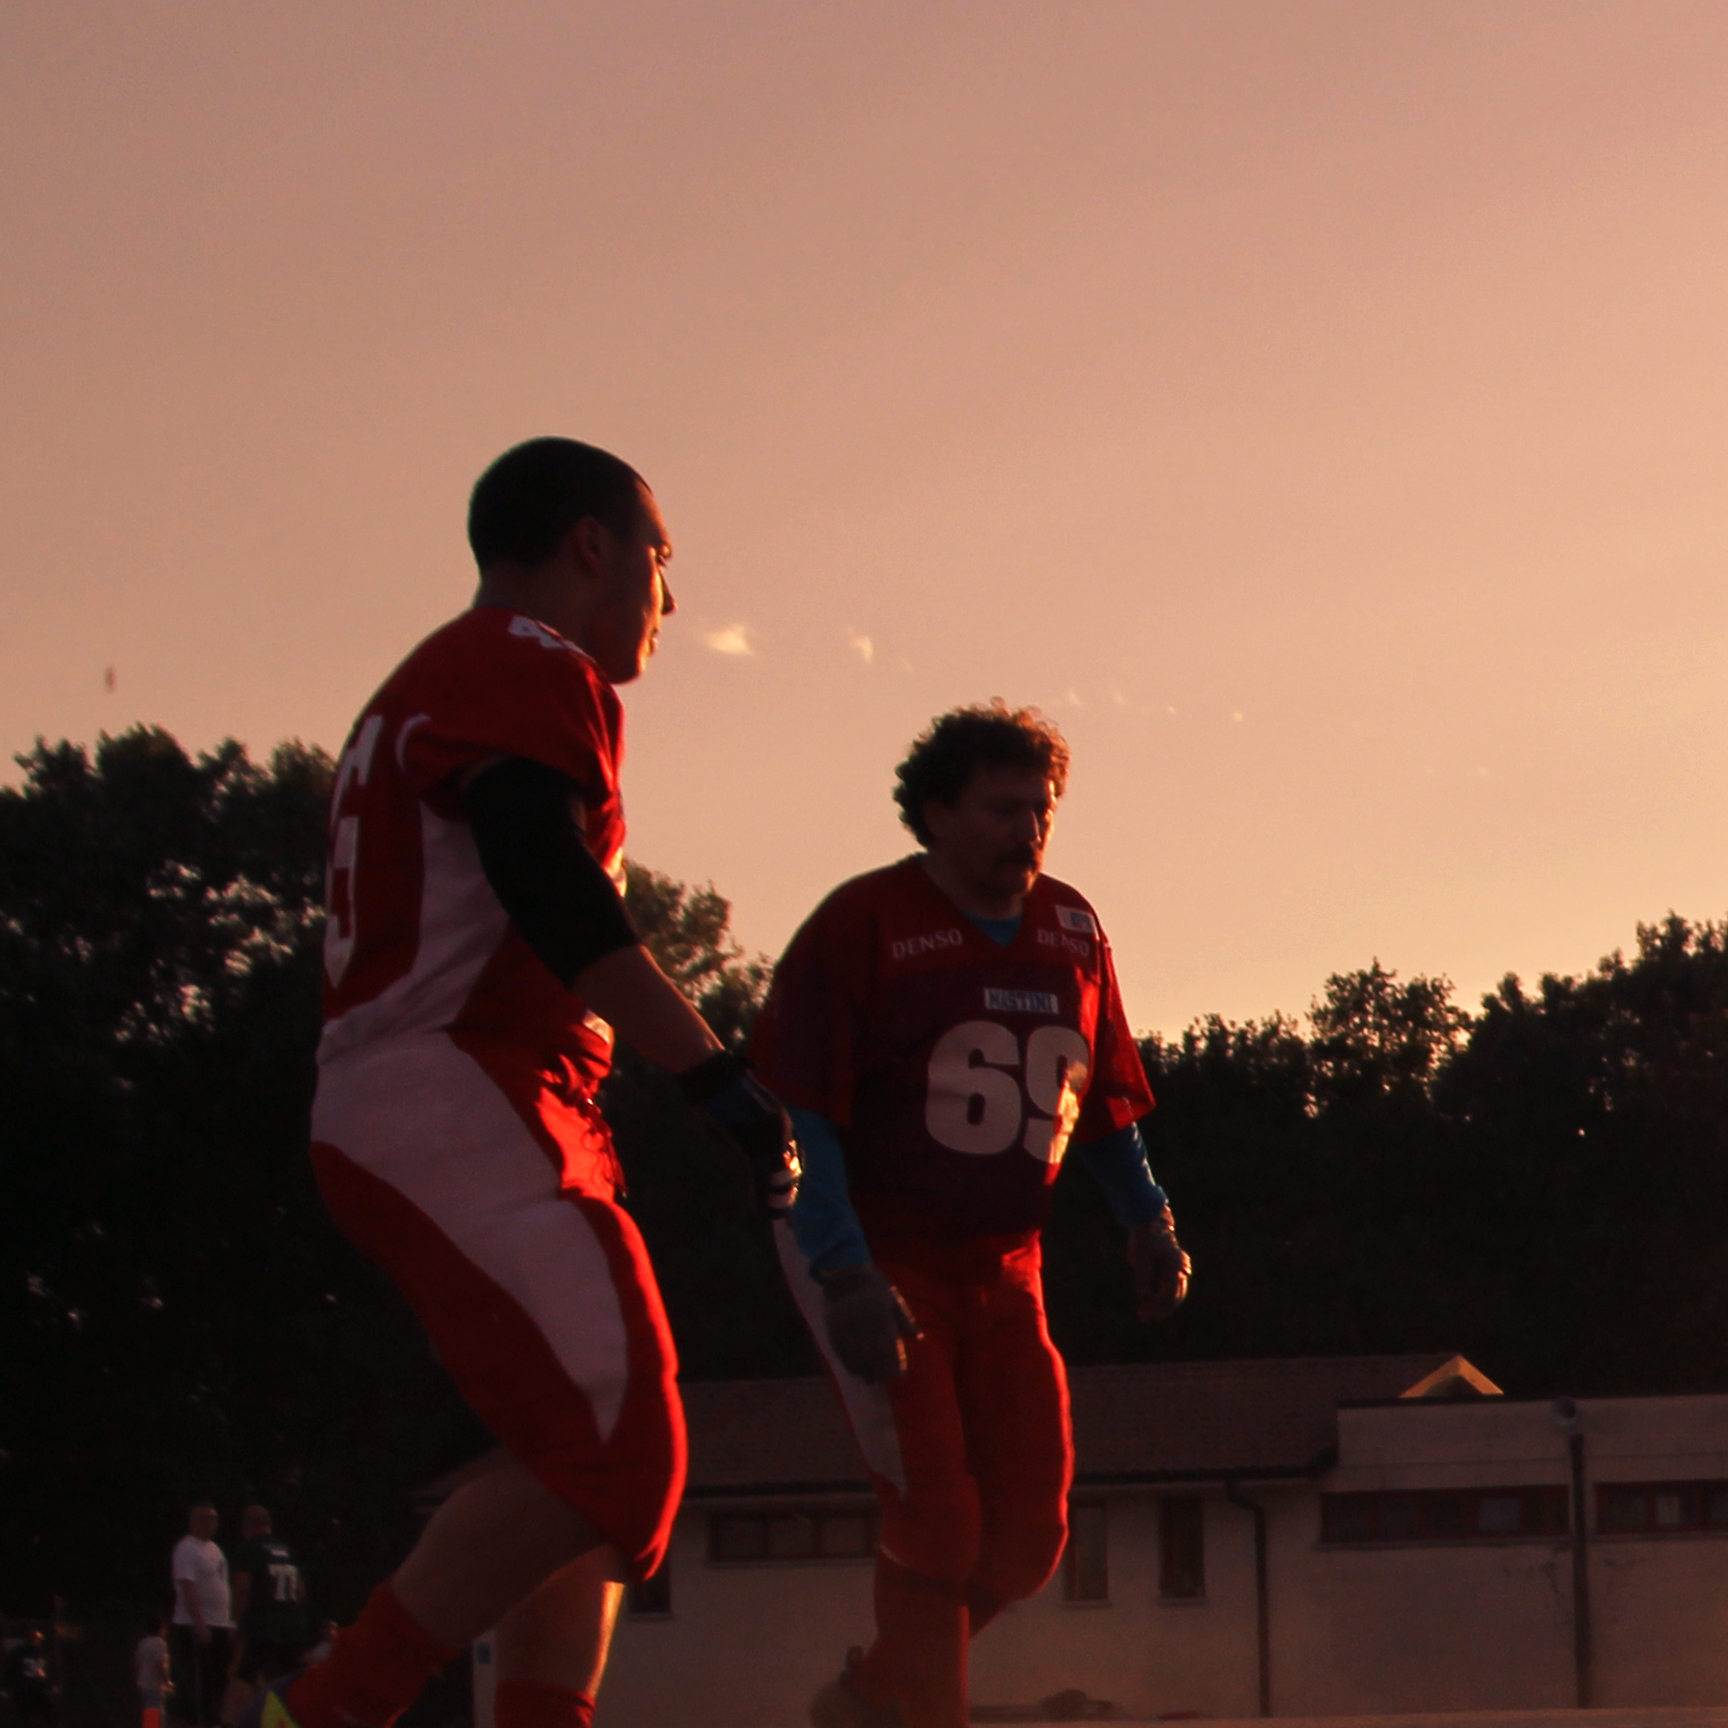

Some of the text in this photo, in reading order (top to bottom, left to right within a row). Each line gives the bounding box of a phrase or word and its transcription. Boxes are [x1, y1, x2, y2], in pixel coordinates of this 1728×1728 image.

[892, 928, 963, 960] DENSO
[1037, 928, 1090, 957] DENSO
[924, 1019, 1090, 1164] 69
